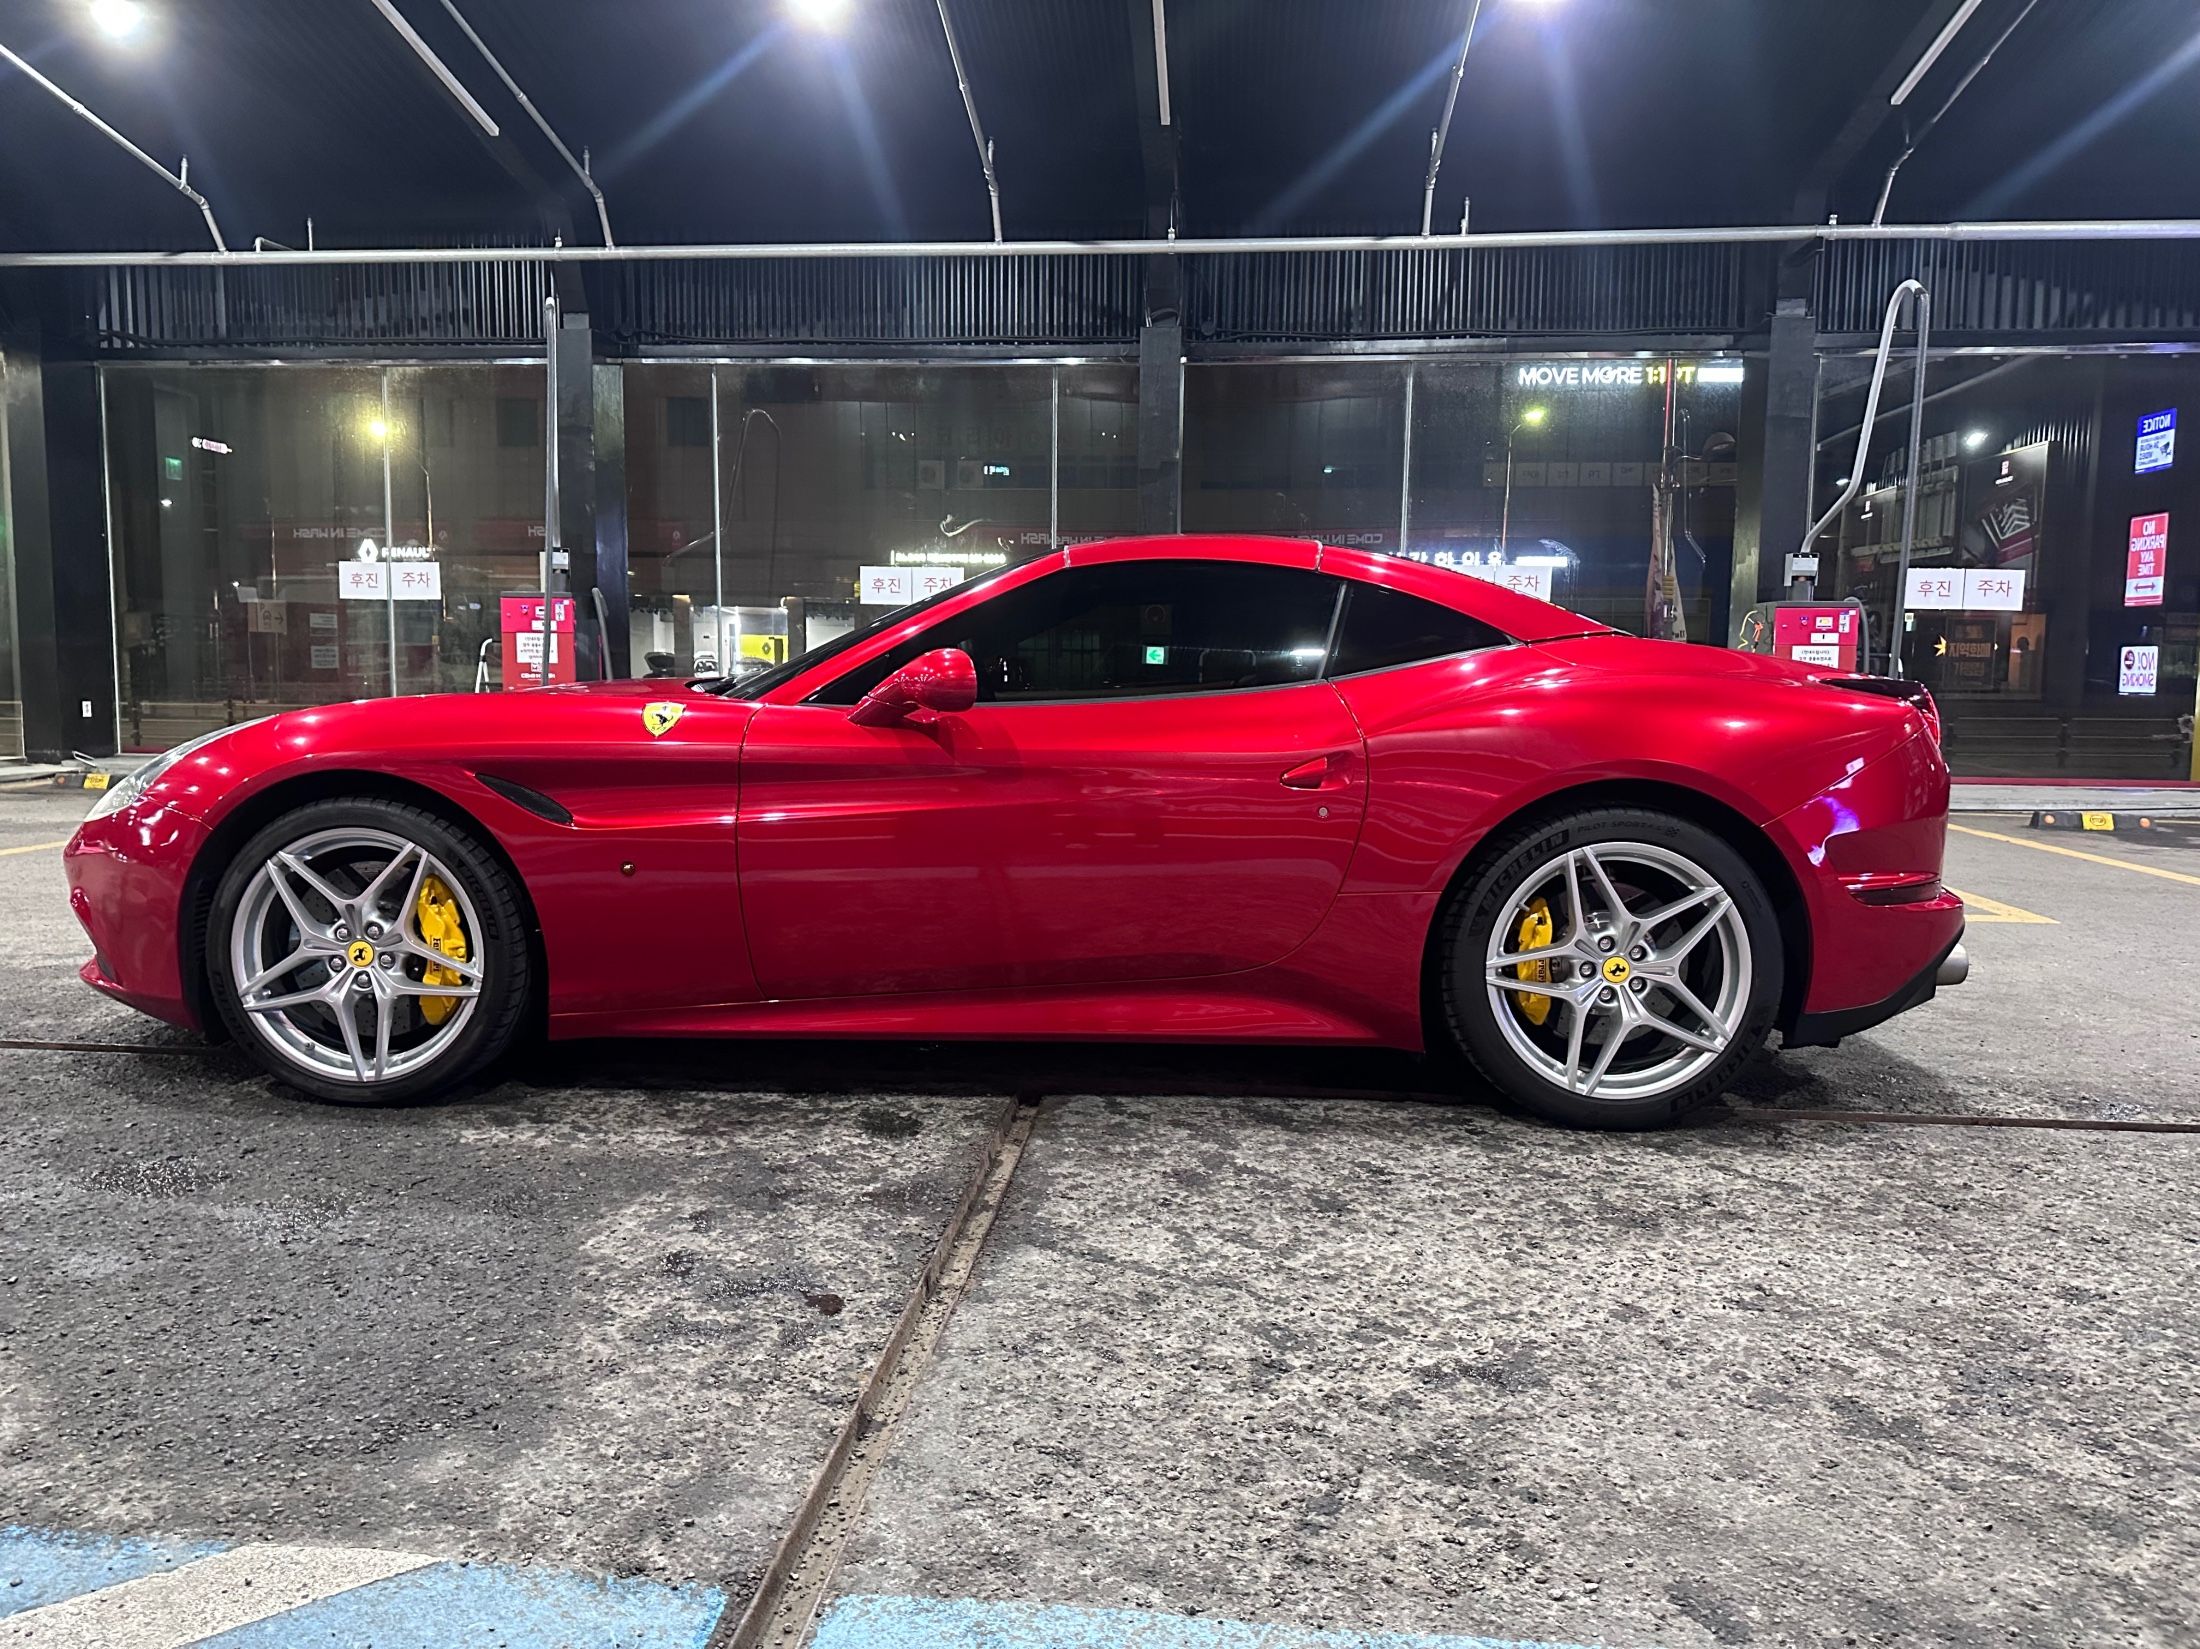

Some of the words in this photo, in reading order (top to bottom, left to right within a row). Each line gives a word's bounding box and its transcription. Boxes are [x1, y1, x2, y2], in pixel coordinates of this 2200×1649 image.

[1519, 368, 1579, 385] MOVE
[1582, 367, 1642, 384] MORE
[1646, 366, 1666, 384] 1:1
[350, 572, 379, 589] 후진
[401, 572, 431, 588] 주차
[871, 576, 902, 594] 후진
[923, 576, 953, 594] 주차
[1507, 574, 1541, 592] 주차
[1918, 579, 1952, 598] 후진
[1977, 579, 2013, 598] 주차
[1481, 828, 1569, 910] MICHELIN
